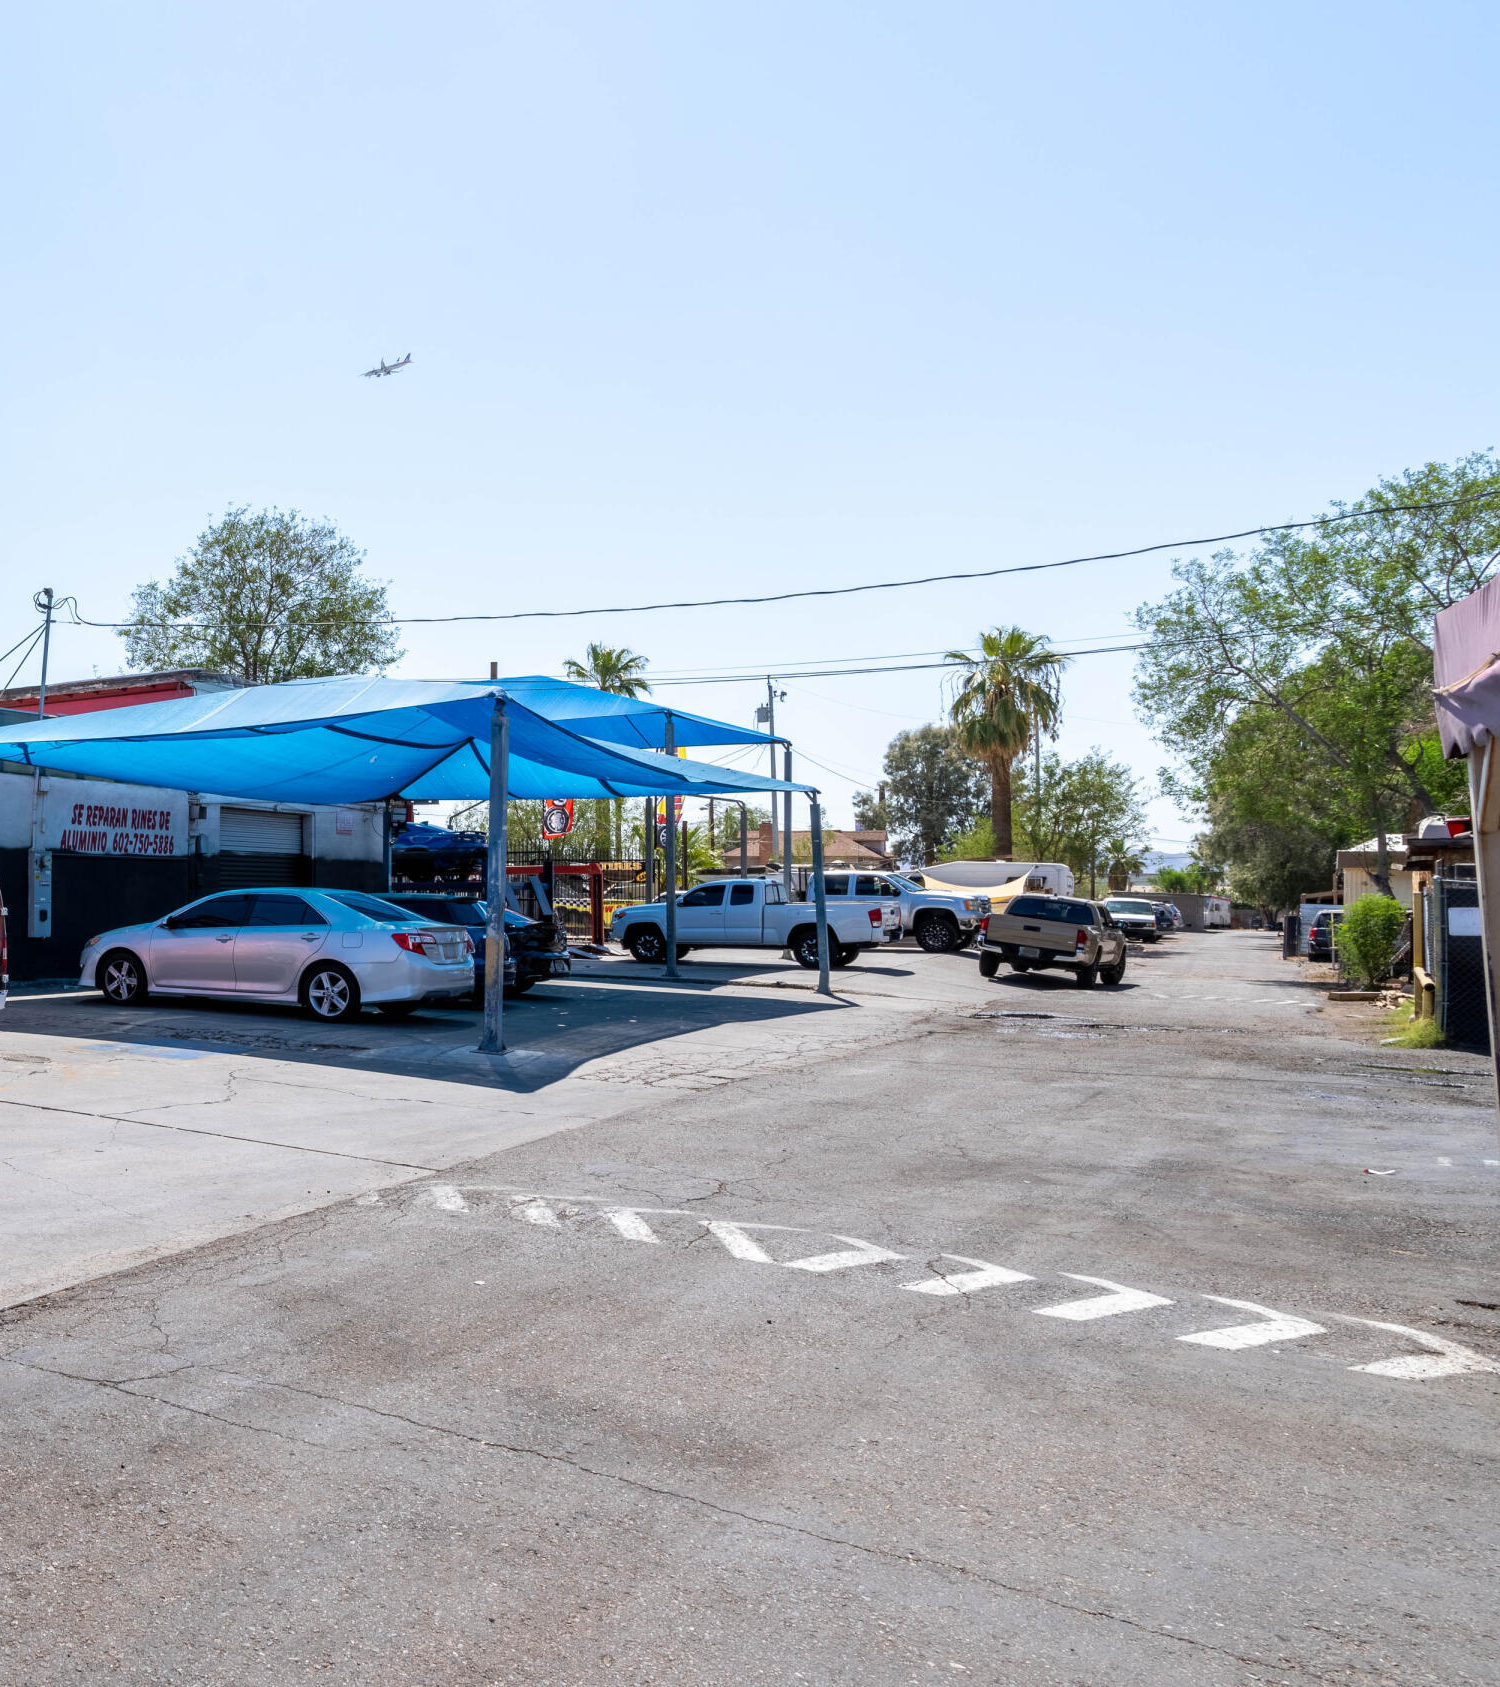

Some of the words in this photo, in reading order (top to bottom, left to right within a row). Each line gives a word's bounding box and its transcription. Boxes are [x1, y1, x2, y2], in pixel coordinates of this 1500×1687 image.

[71, 804, 84, 825] SE
[86, 805, 128, 829] REPARAN
[131, 809, 157, 830] RINES
[158, 811, 171, 831] DE
[60, 829, 107, 852] ALUMINIO
[112, 832, 174, 855] 602-750-5886
